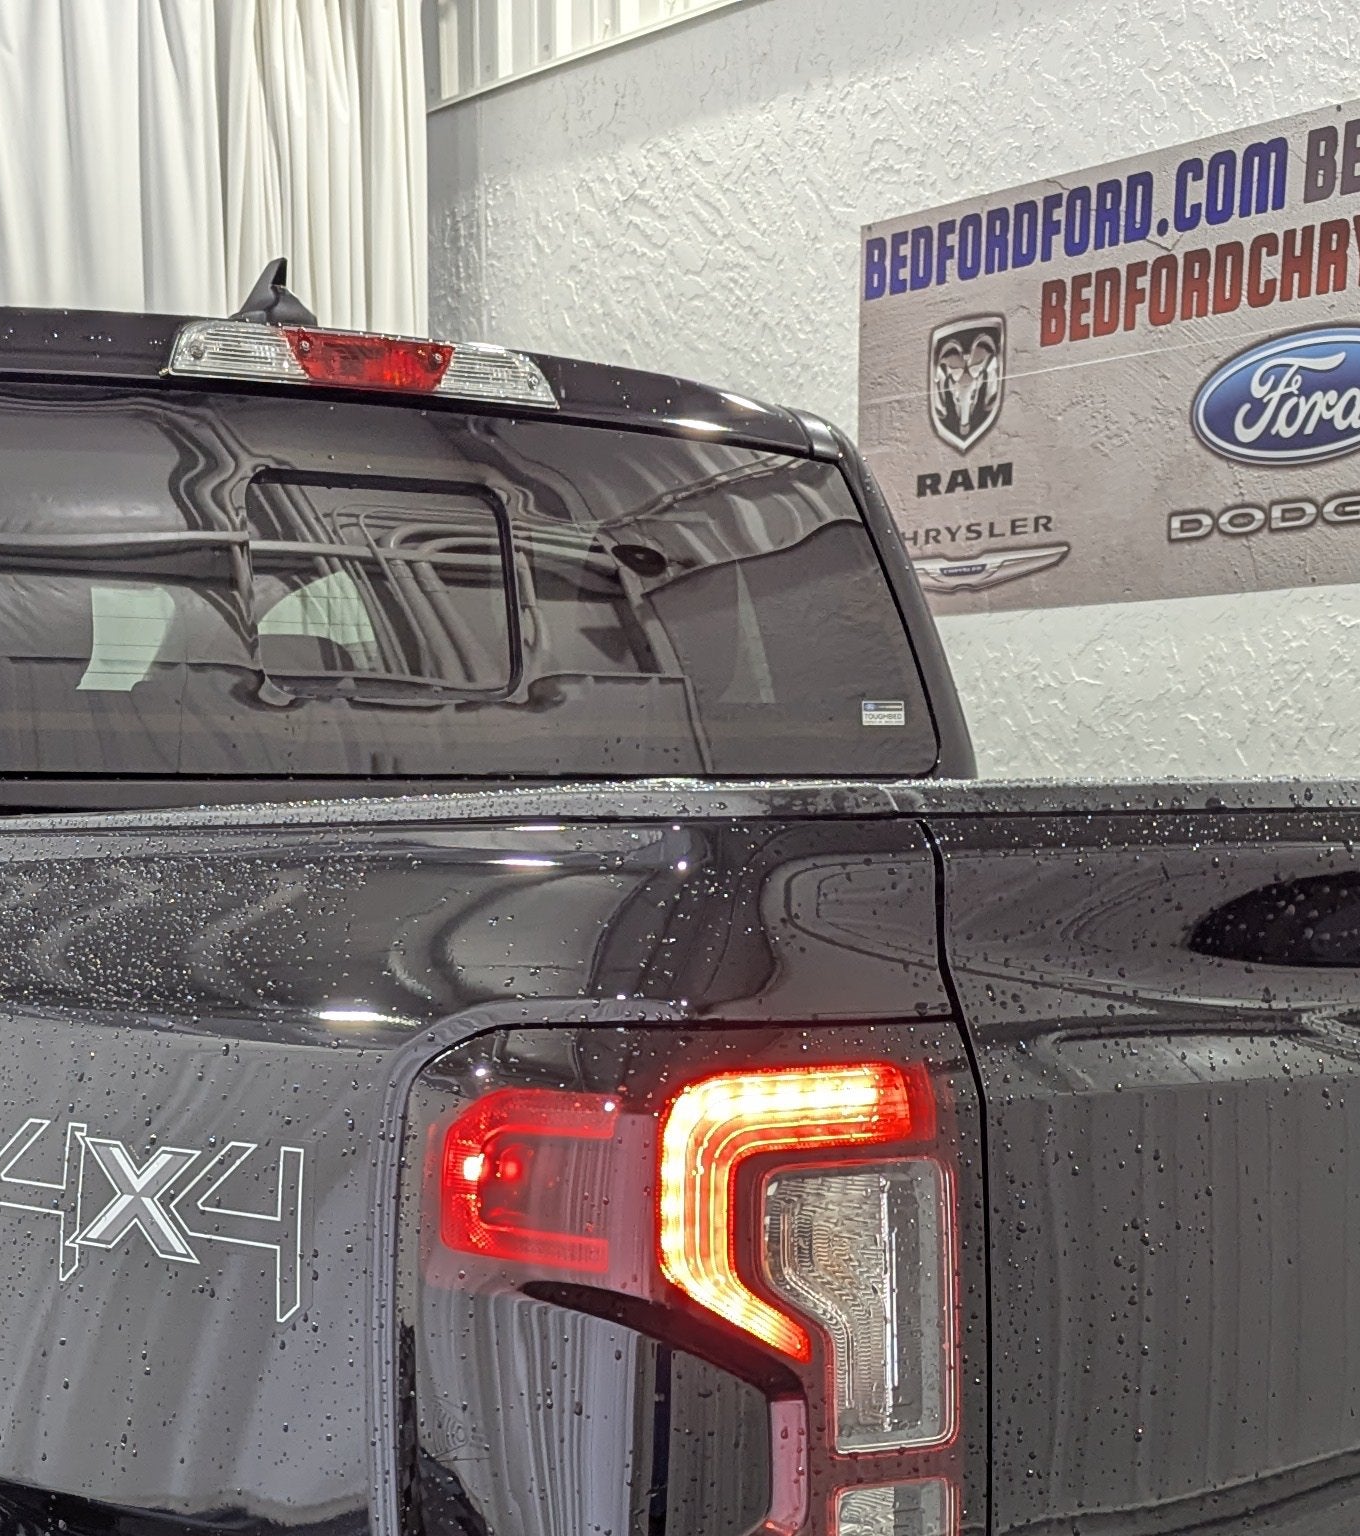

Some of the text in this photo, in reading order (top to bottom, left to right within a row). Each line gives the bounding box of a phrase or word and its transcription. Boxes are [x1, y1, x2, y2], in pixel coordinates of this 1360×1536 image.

[864, 136, 1289, 300] BEDFORDFORD.COM
[917, 462, 1013, 498] RAM
[901, 514, 1053, 547] HRYSLER
